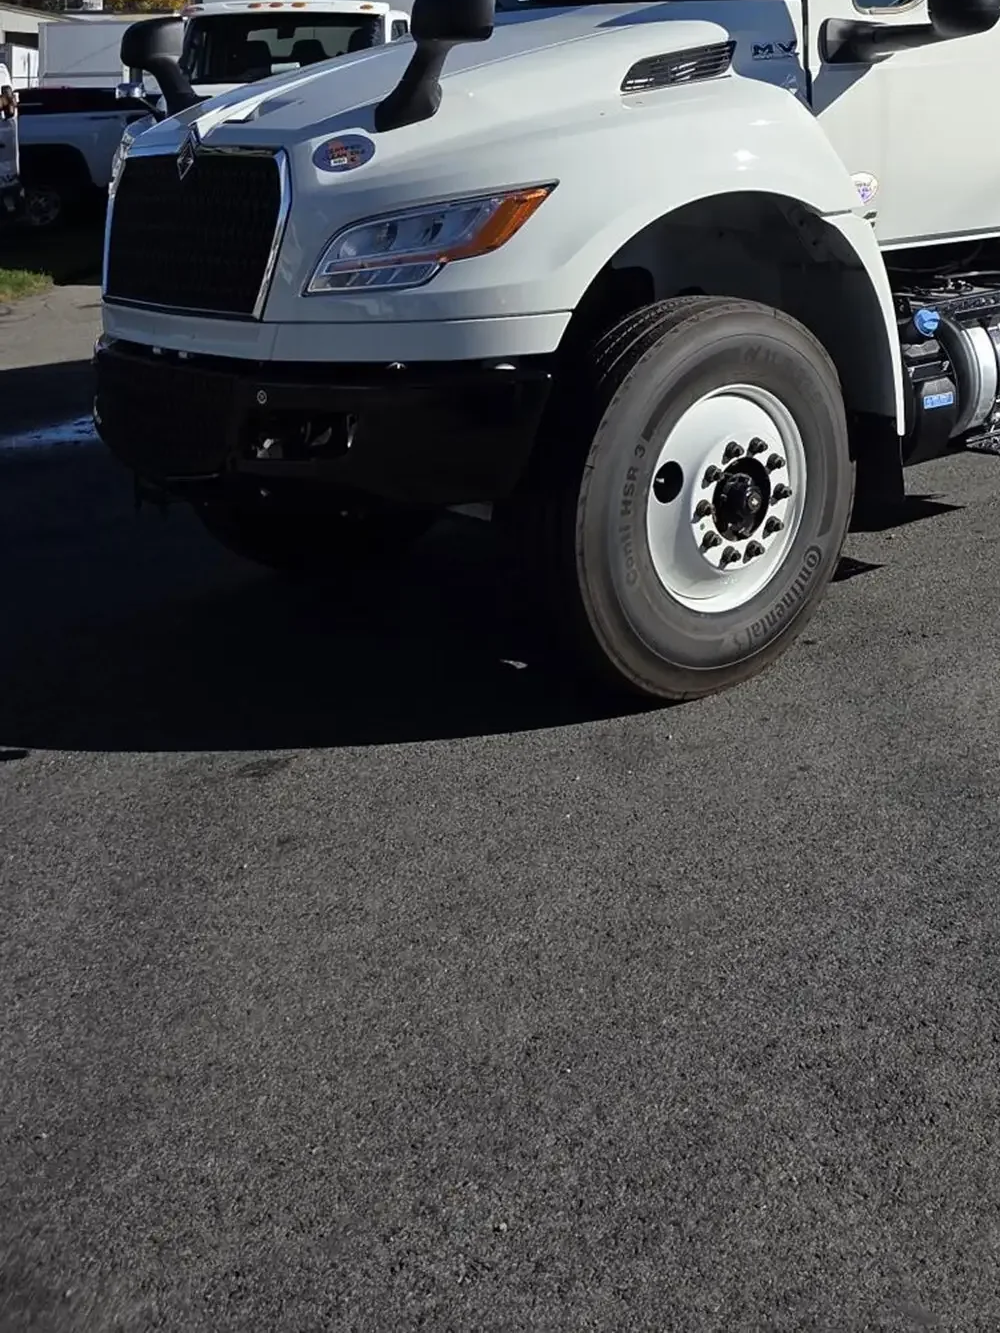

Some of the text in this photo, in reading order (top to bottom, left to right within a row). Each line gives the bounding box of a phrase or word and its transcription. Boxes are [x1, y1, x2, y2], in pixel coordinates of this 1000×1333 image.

[752, 40, 797, 59] MV
[620, 466, 640, 518] HSR
[745, 545, 823, 649] Continental
